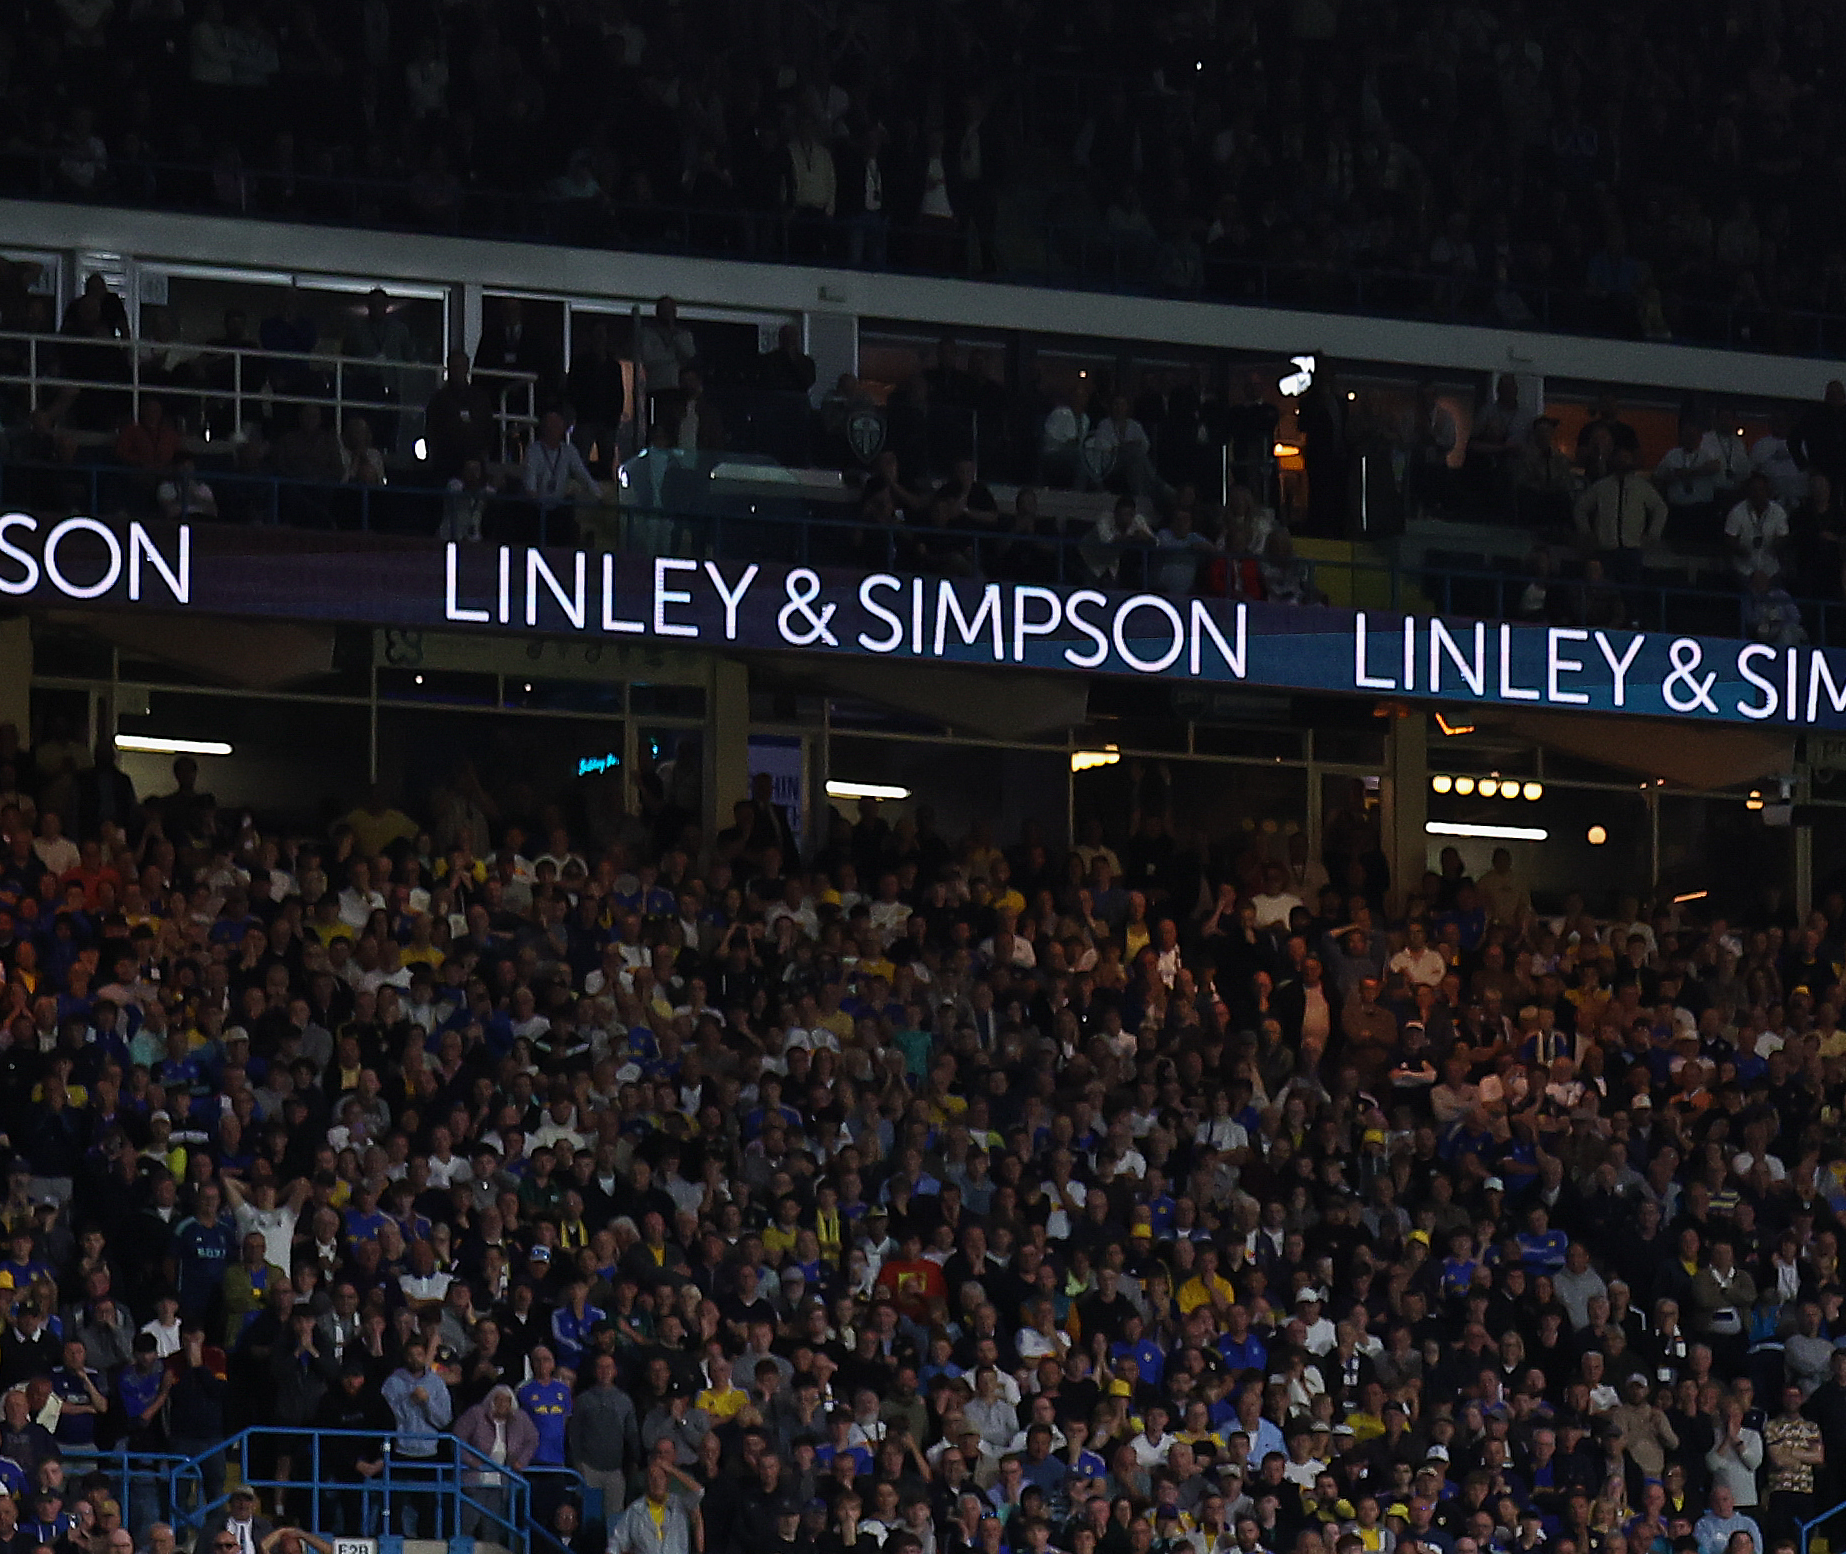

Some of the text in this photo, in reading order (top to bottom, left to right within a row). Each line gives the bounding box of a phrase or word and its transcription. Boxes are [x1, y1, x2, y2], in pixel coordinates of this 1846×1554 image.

[445, 541, 1248, 679] LINLEY & SIMPSON
[1354, 611, 1646, 707] LINLEY
[1661, 637, 1720, 714] &
